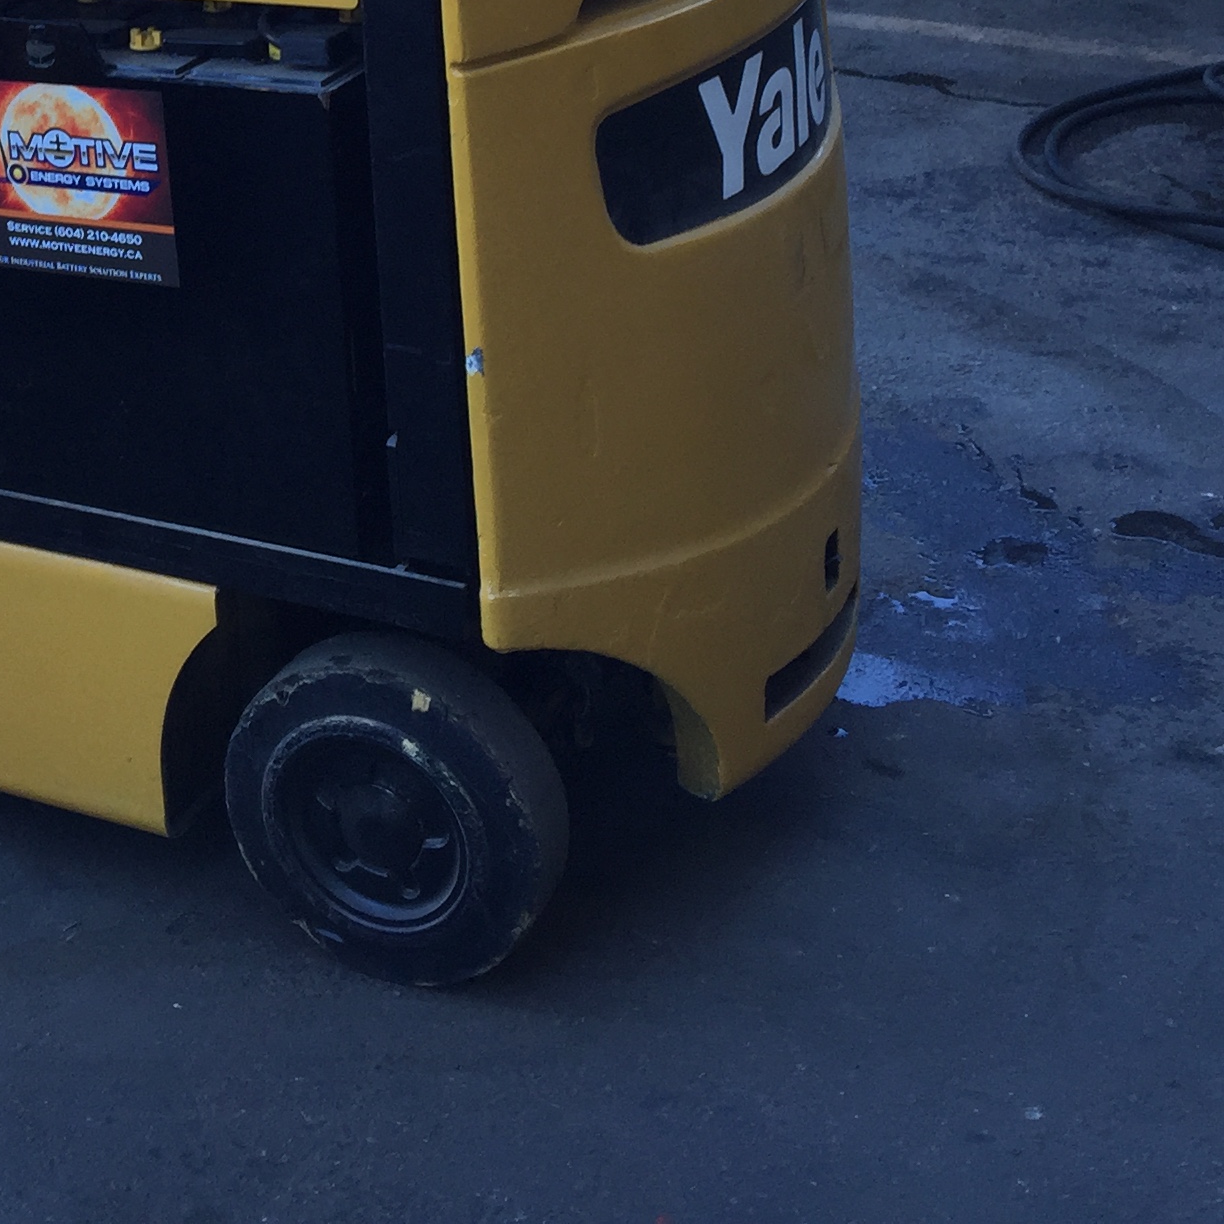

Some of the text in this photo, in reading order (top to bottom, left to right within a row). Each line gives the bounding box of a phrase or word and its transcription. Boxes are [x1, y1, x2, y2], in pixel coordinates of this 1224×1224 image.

[698, 18, 825, 200] Yale
[7, 127, 158, 173] MOTIVE
[30, 170, 150, 192] ENERGY SYSTEMS
[6, 220, 53, 236] SERVICE
[54, 225, 84, 240] (604)
